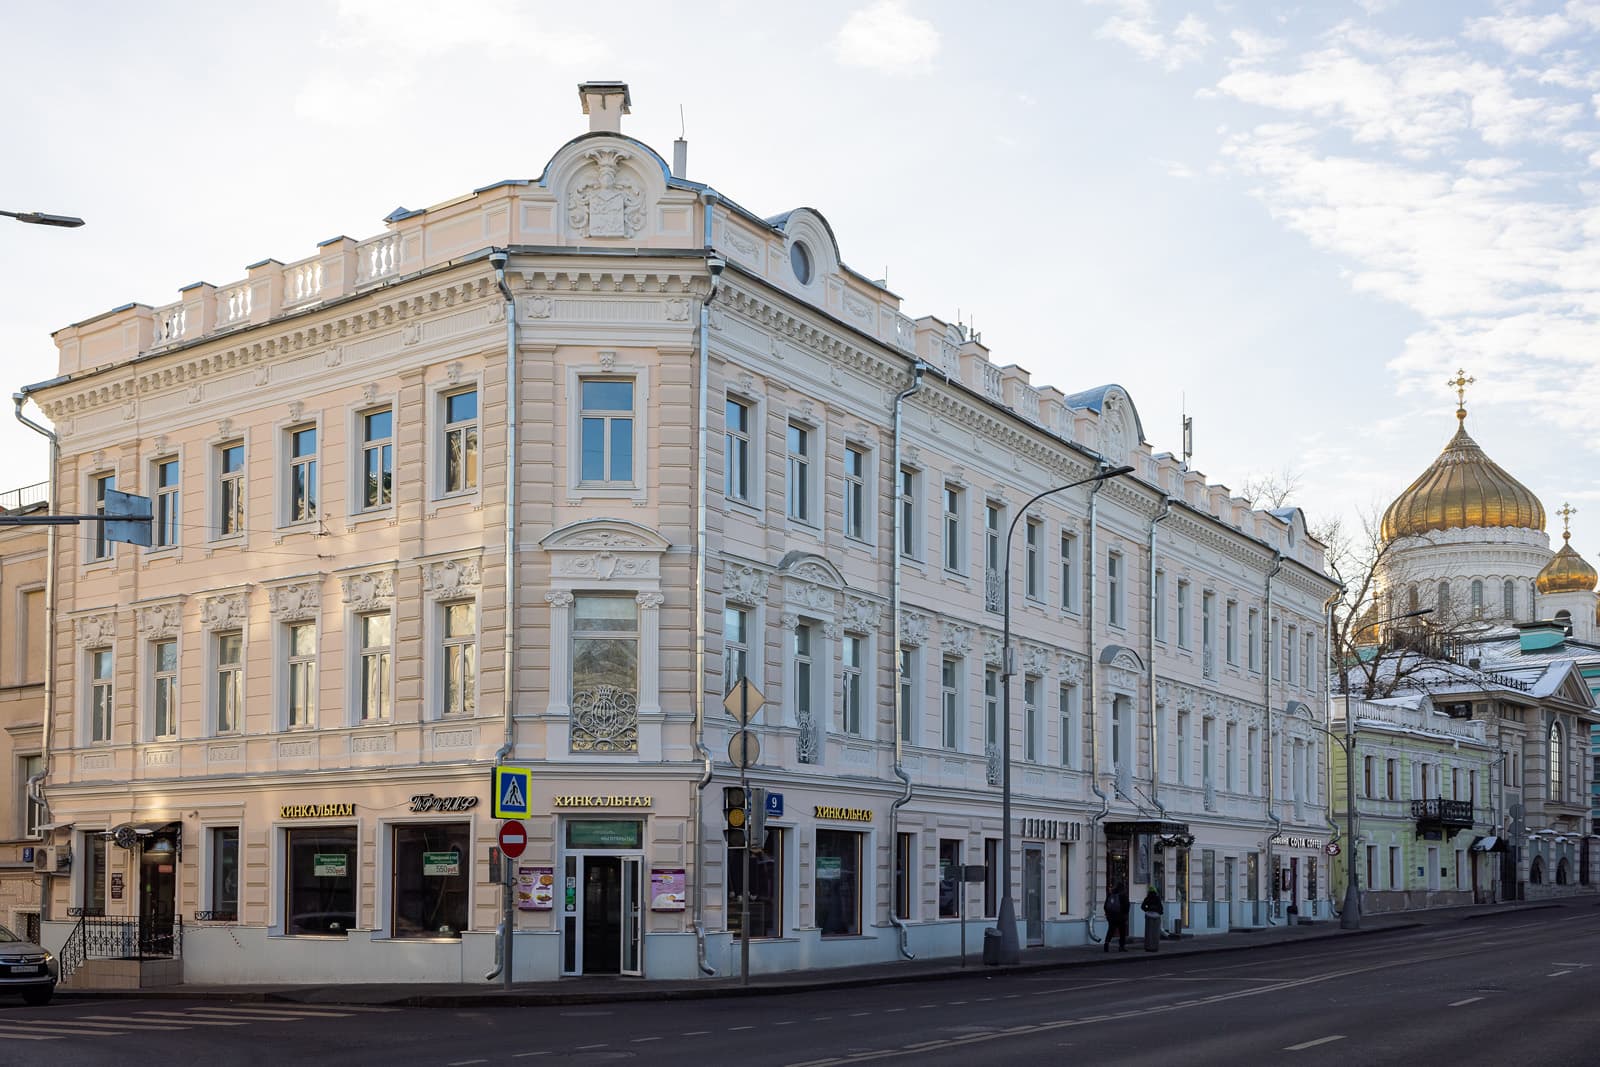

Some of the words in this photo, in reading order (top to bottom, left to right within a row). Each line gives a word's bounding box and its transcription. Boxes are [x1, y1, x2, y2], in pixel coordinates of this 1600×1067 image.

[554, 795, 652, 807] ХИНКАЛЬНАЯ
[771, 796, 778, 808] 9
[280, 803, 355, 818] ХИНКАЛЬНАЯ
[815, 805, 873, 822] ХИНКАЛЬНАЯ
[1290, 837, 1306, 849] COSTA
[1306, 839, 1322, 850] COFFEE
[436, 865, 447, 873] 550
